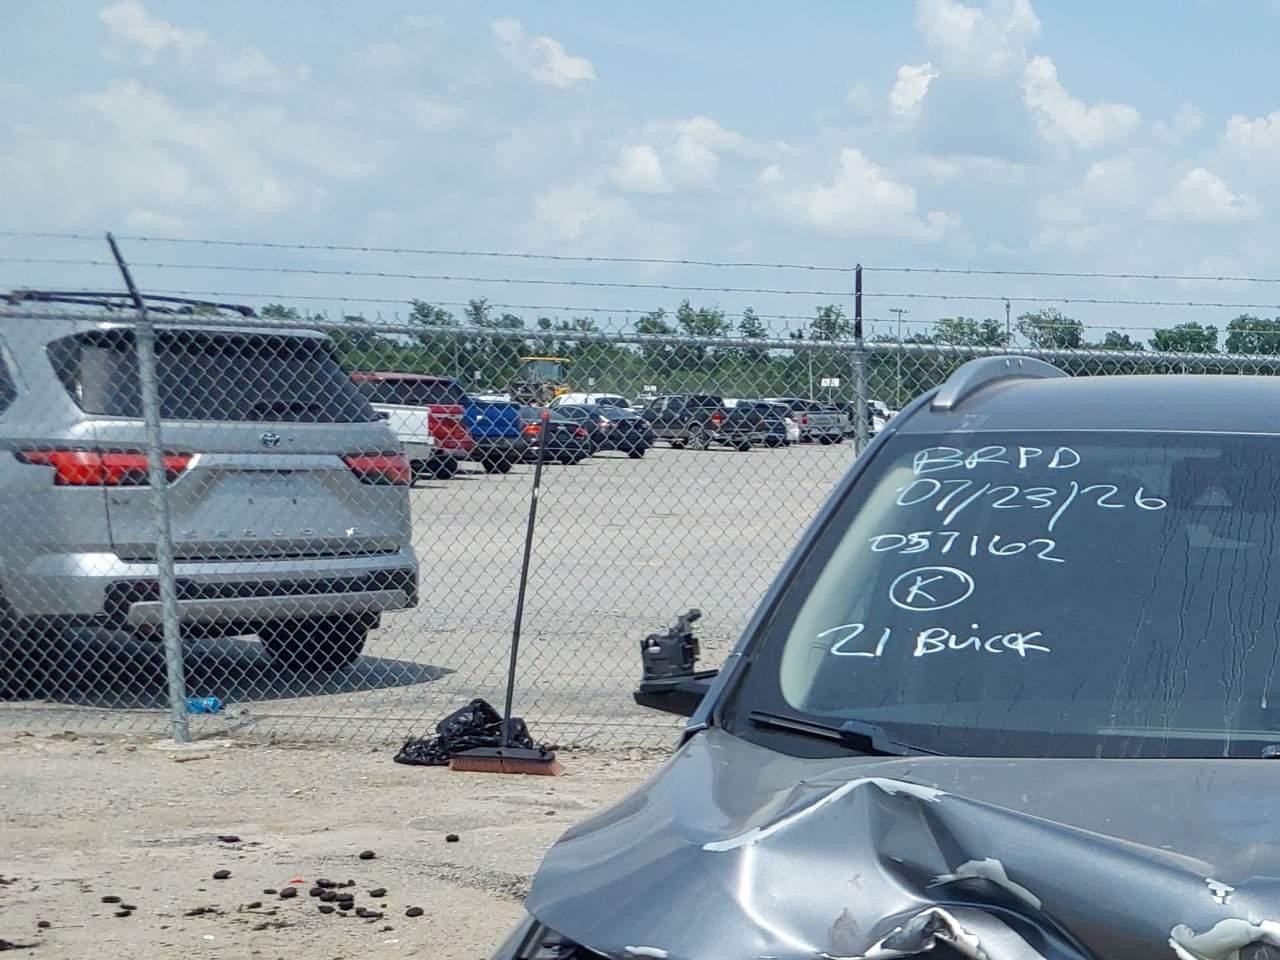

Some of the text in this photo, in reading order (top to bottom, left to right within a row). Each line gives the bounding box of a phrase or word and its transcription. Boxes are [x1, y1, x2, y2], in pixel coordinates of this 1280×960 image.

[913, 446, 1081, 474] BRPD
[896, 478, 1167, 531] 07/23/26
[868, 531, 1066, 563] 057162
[906, 575, 945, 603] K
[817, 623, 891, 657] 21
